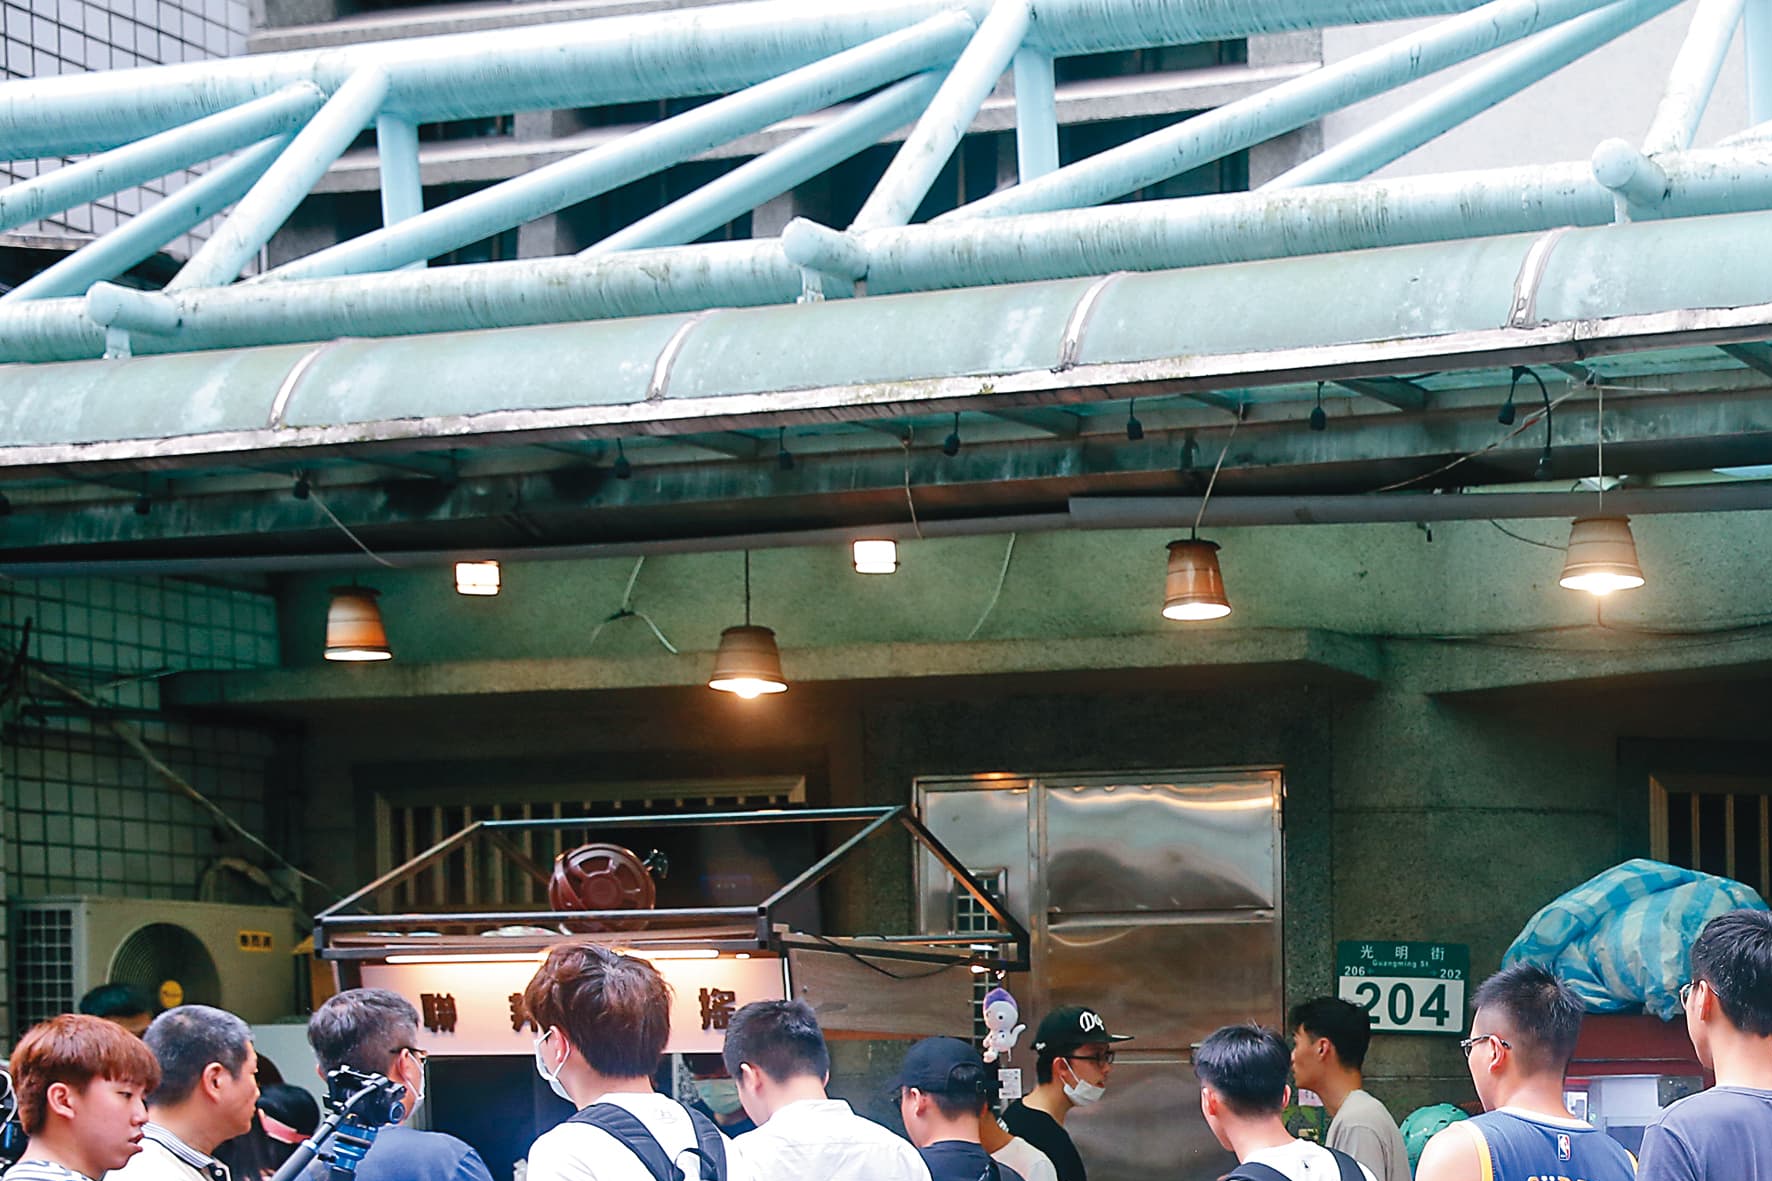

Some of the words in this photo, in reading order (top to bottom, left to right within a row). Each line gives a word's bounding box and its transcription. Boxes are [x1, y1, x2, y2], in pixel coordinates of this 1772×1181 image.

[1360, 944, 1445, 961] 光明街
[1372, 959, 1417, 968] Guangming
[1344, 966, 1366, 976] 206
[1440, 968, 1462, 979] 202
[1355, 981, 1450, 1027] 204
